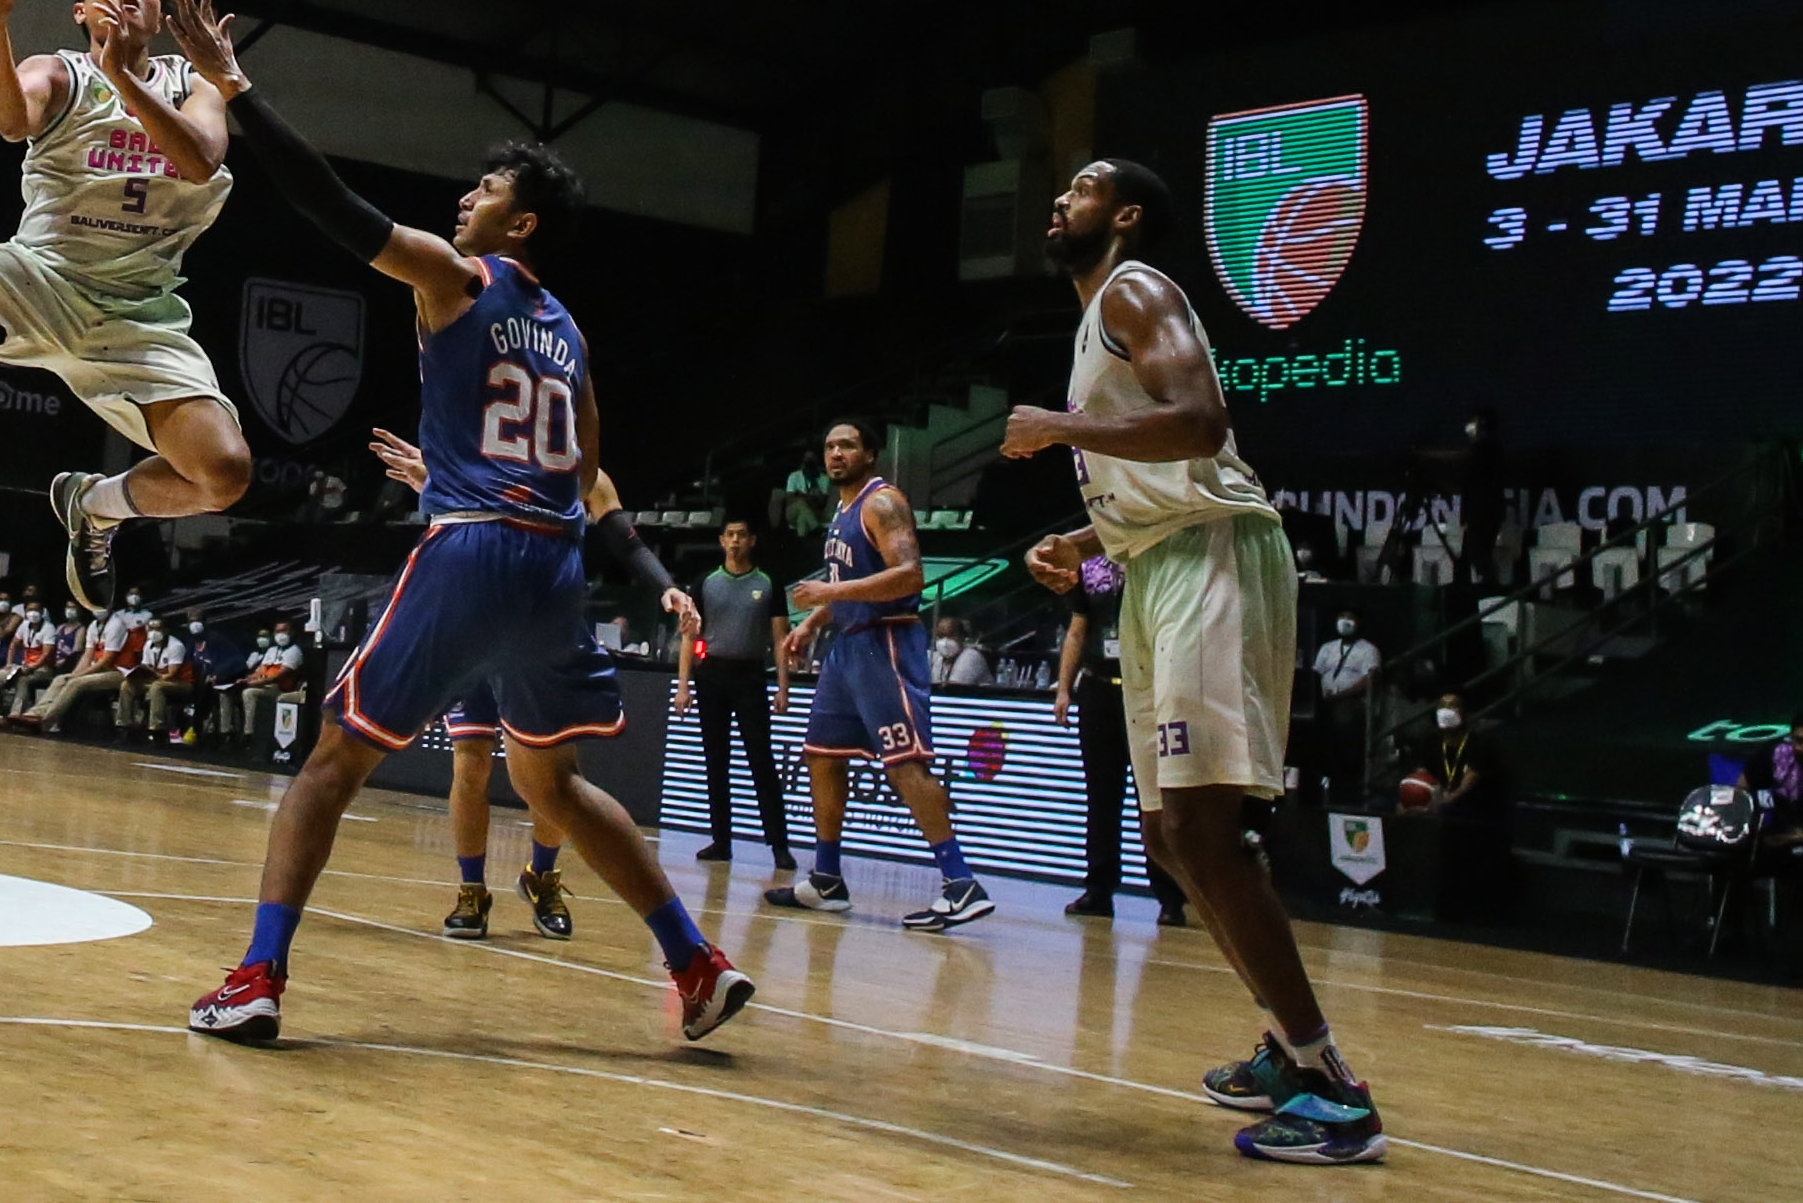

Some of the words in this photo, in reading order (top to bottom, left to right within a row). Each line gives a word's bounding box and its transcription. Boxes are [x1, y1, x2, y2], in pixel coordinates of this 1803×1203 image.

[88, 148, 181, 178] UNITE
[1223, 130, 1303, 181] IBL
[121, 177, 149, 214] 5
[1483, 206, 1528, 250] 3
[1584, 192, 1662, 241] 31
[1682, 176, 1803, 232] MA
[1606, 255, 1803, 312] 2022
[256, 295, 317, 337] IBL
[490, 316, 577, 380] GOVINDA
[481, 360, 580, 472] 20
[878, 721, 911, 751] 33
